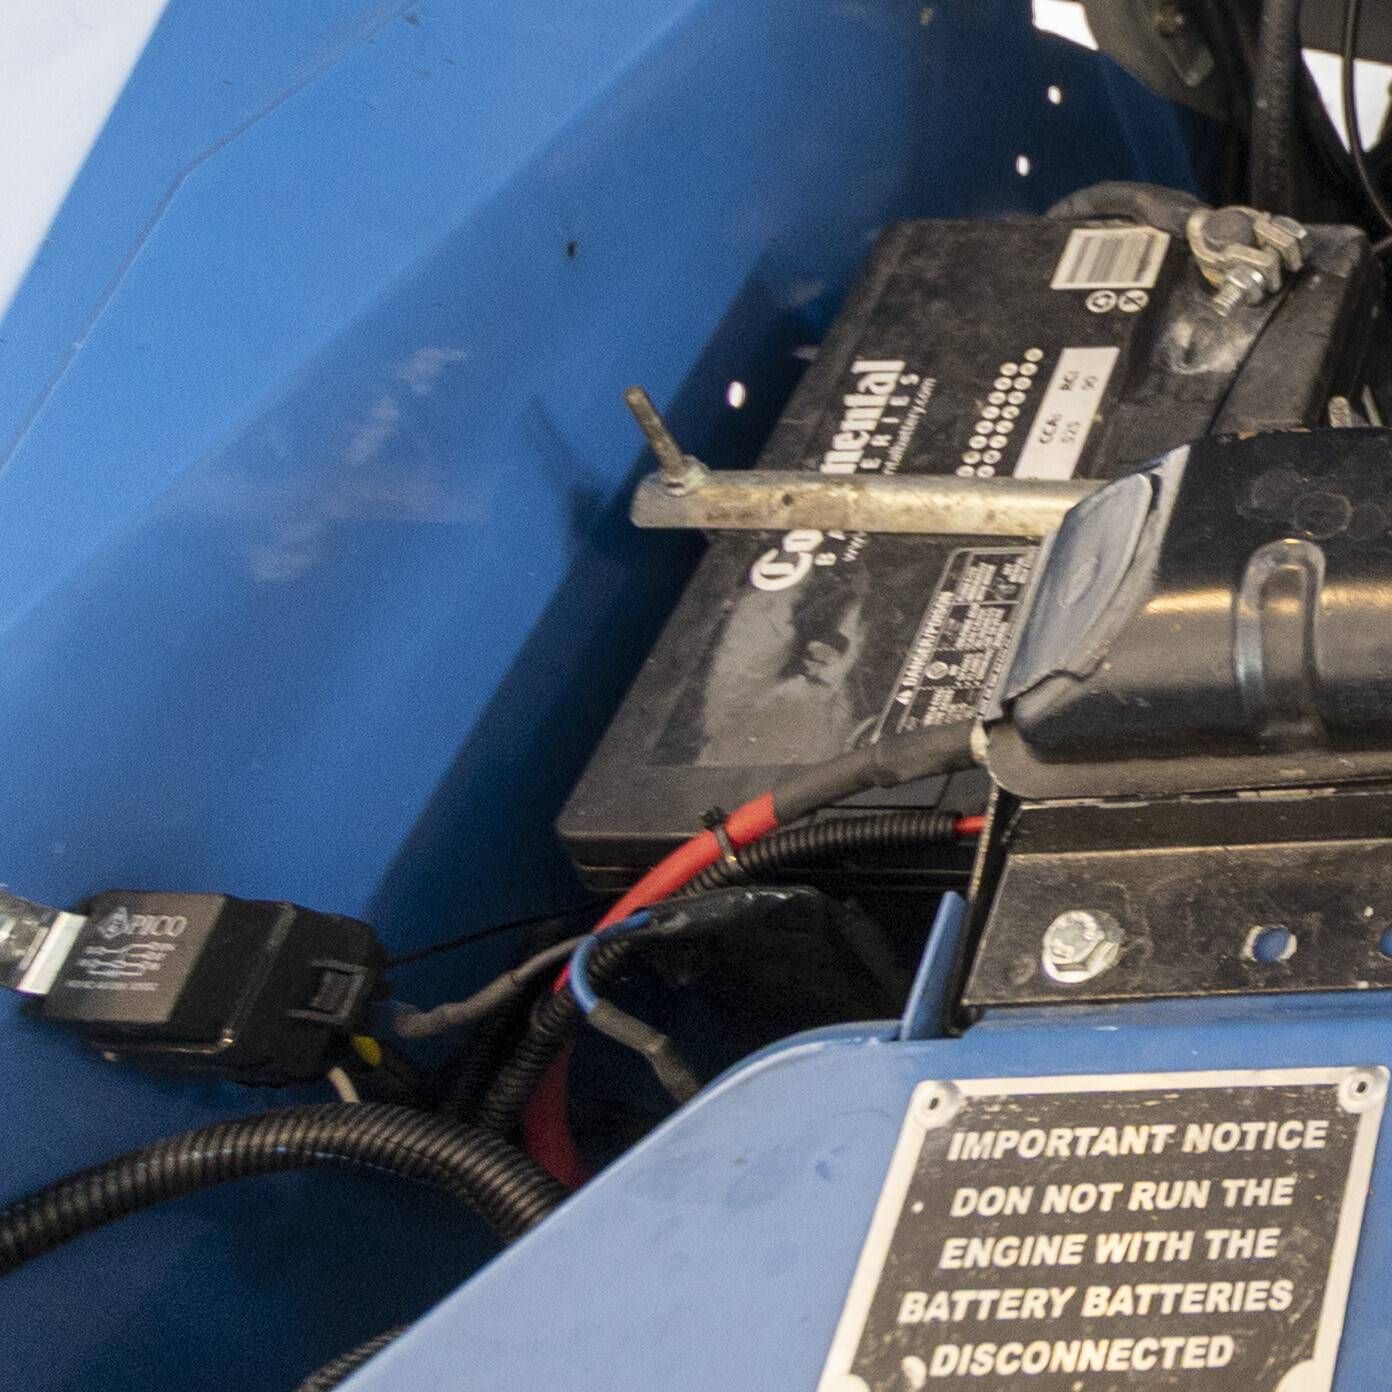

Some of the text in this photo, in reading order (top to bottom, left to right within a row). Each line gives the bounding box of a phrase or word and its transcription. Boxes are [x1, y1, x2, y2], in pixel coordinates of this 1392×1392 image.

[751, 360, 906, 591] Conental
[948, 1119, 1330, 1162] IMPORTANT NOTICE
[951, 1177, 1297, 1217] DON NOT RUN THE
[939, 1227, 1282, 1269] ENGINE WITH THE
[897, 1279, 1295, 1324] BATTERY BATTERIES
[930, 1334, 1236, 1378] DISCONNECTED
